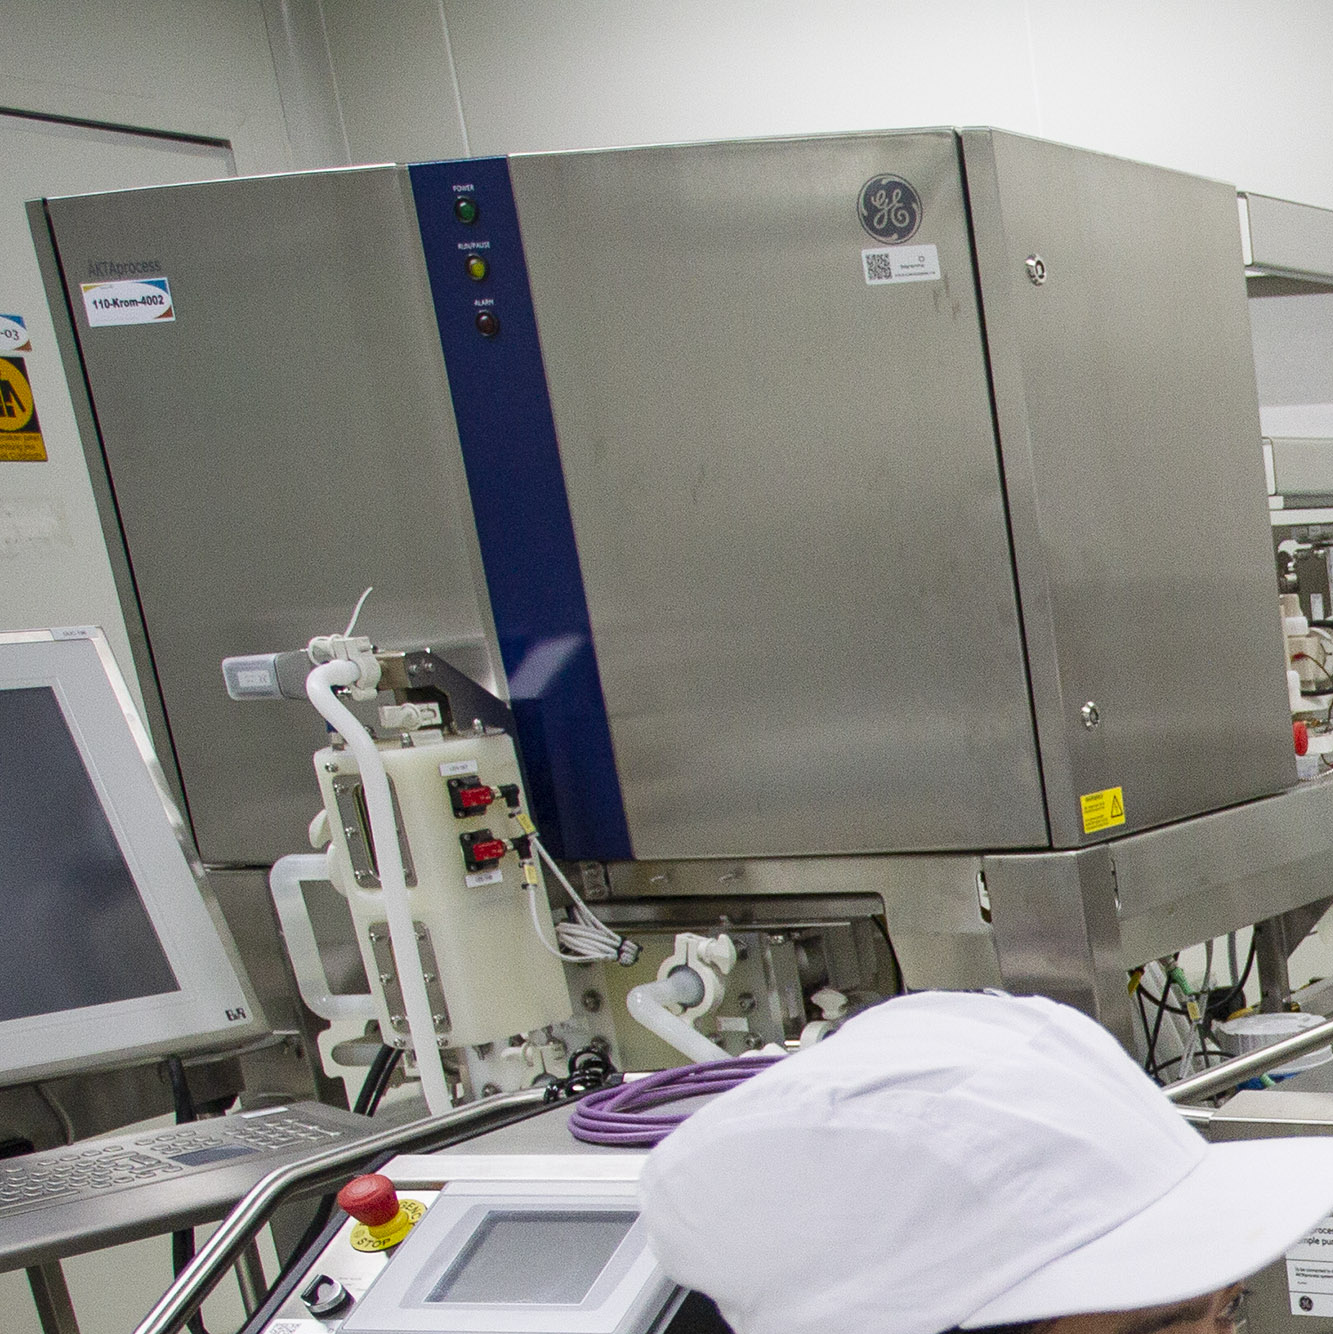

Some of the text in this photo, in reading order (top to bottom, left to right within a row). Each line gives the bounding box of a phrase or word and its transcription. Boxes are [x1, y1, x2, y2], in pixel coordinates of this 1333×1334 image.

[452, 184, 475, 193] POWER
[92, 294, 165, 311] 110-Krom-4002
[473, 299, 495, 307] ALARM
[356, 1237, 391, 1249] STOP
